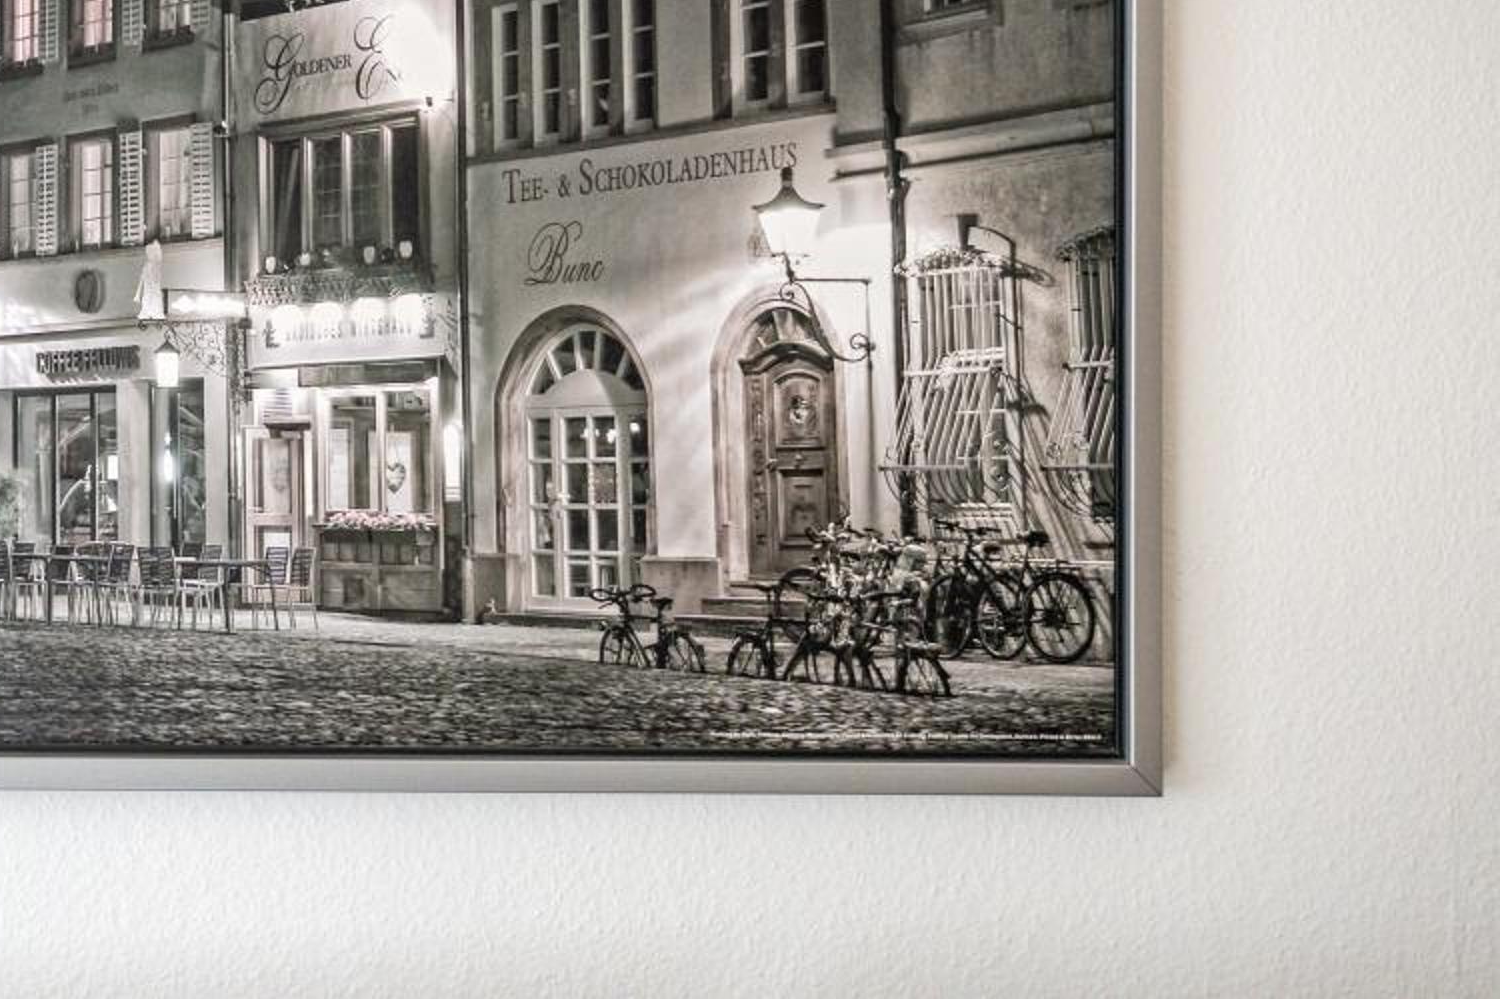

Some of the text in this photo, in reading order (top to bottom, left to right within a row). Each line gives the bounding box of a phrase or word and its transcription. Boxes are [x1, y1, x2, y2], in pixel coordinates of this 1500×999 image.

[254, 32, 352, 116] GOLDENER
[502, 142, 797, 204] TEE- & SCHOKOLADENHAUS
